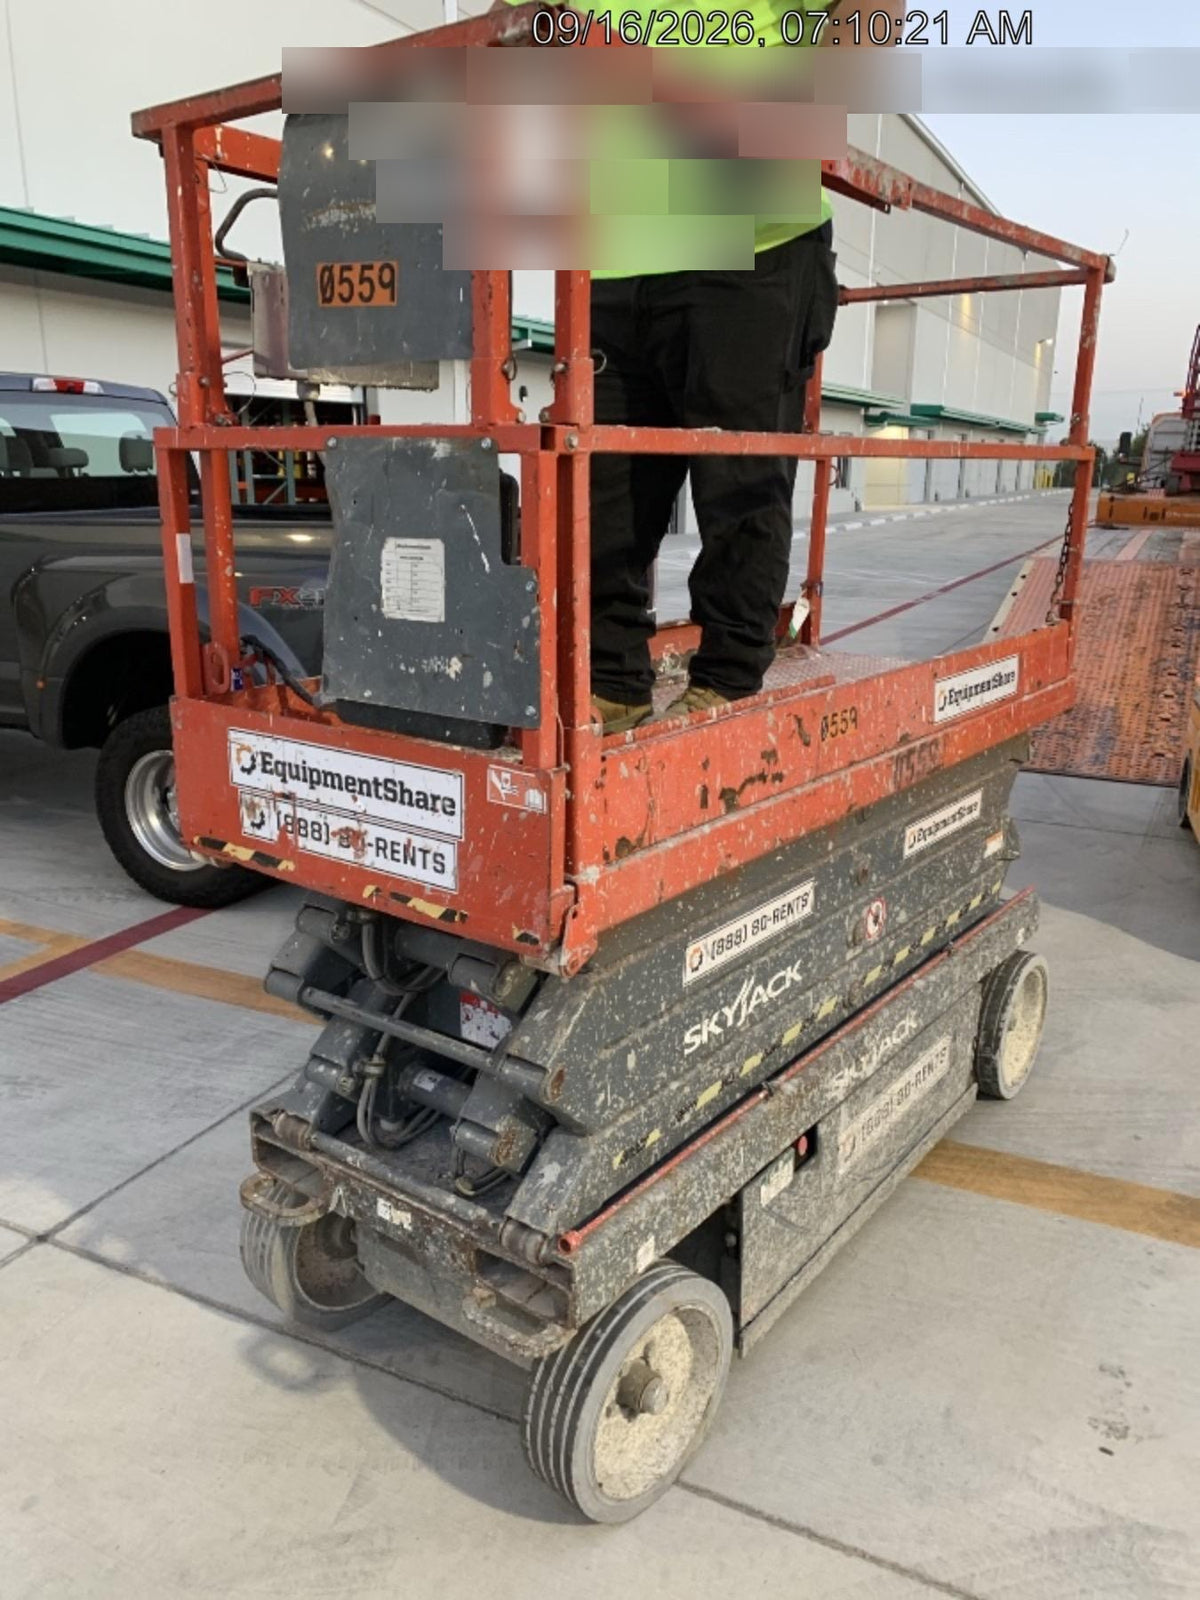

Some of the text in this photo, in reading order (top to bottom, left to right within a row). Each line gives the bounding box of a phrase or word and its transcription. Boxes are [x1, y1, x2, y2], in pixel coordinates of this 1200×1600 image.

[258, 750, 457, 817] EquipmentShare
[711, 892, 810, 961] (888) 80-RENTS
[683, 959, 803, 1057] SKYJACK
